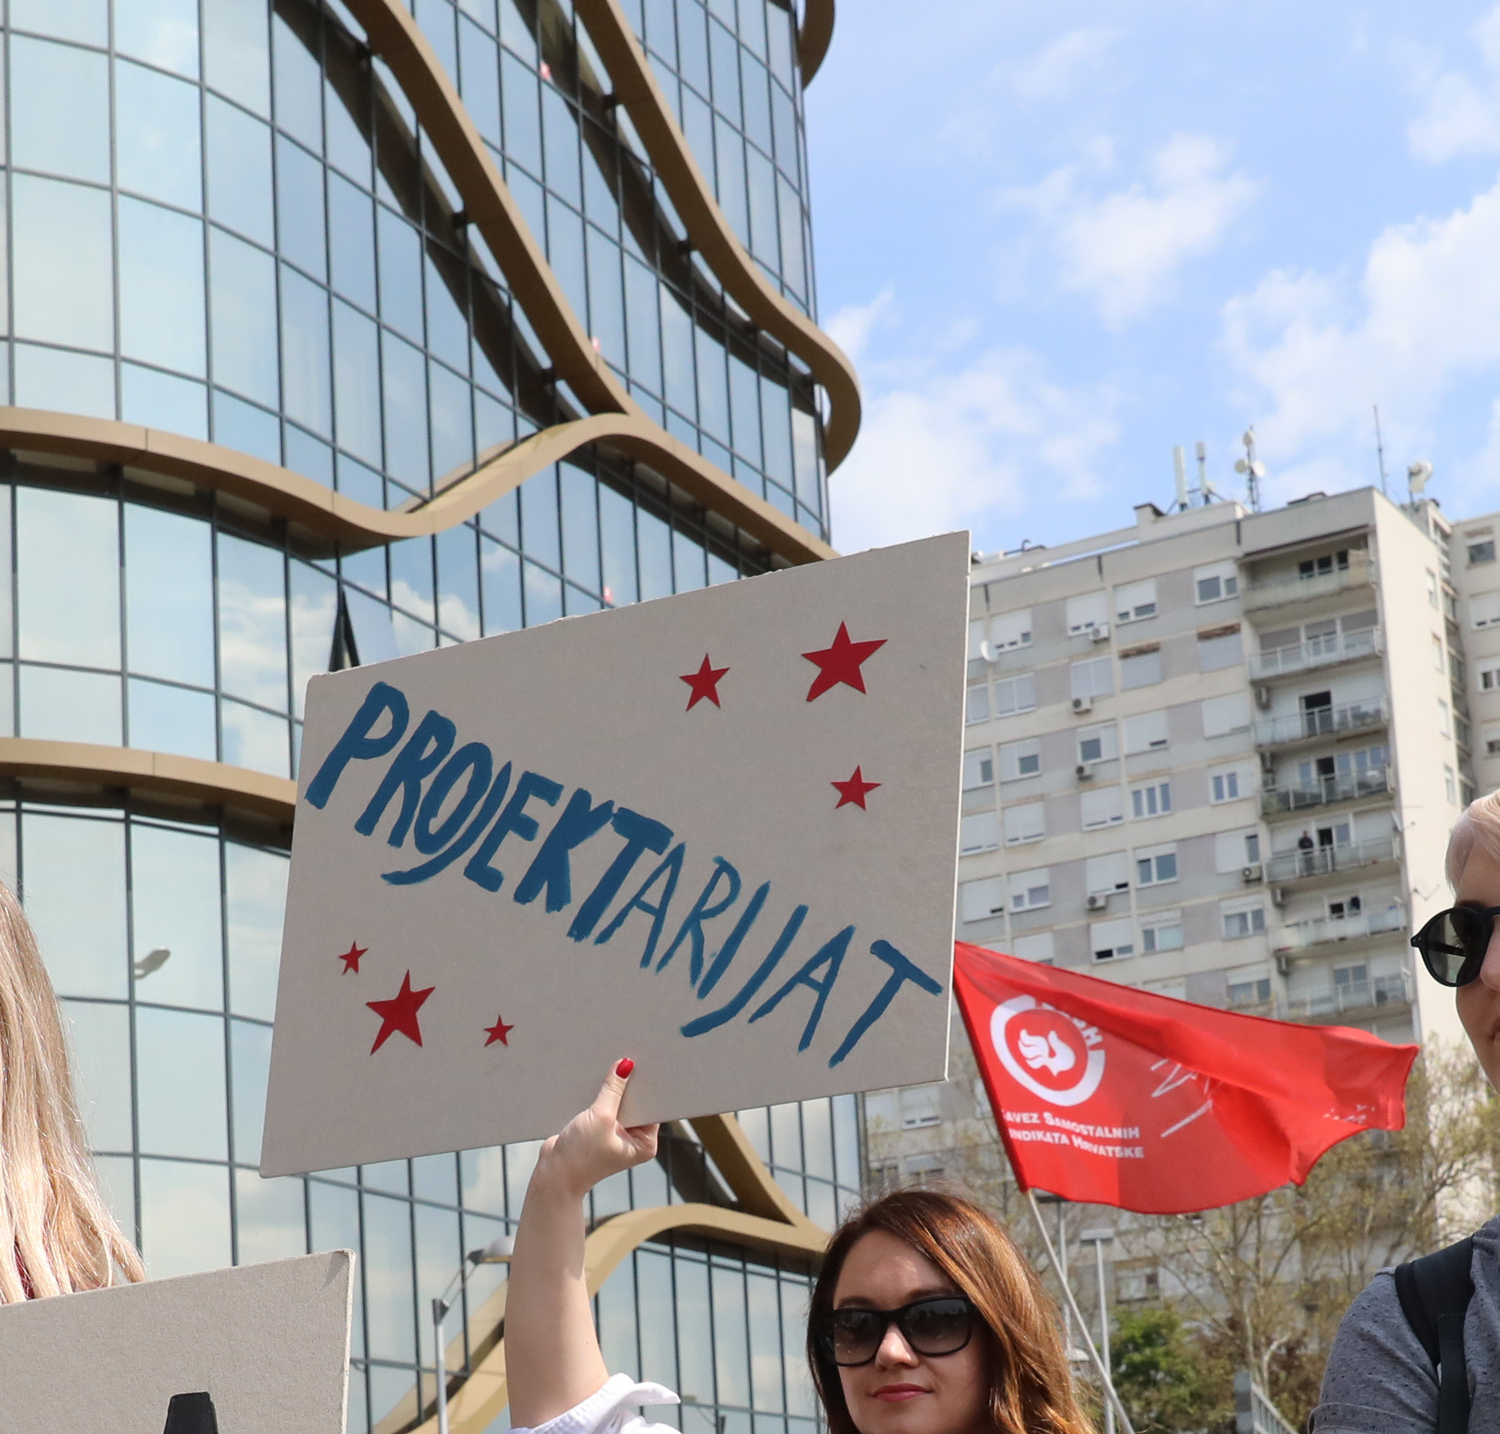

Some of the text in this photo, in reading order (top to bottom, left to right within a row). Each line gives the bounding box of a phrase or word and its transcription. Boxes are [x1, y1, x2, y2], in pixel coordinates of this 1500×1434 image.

[304, 681, 943, 1068] PROJEKTARIJAT
[1002, 1109, 1041, 1124] AVEZ
[1008, 1128, 1070, 1146] INDIKATA
